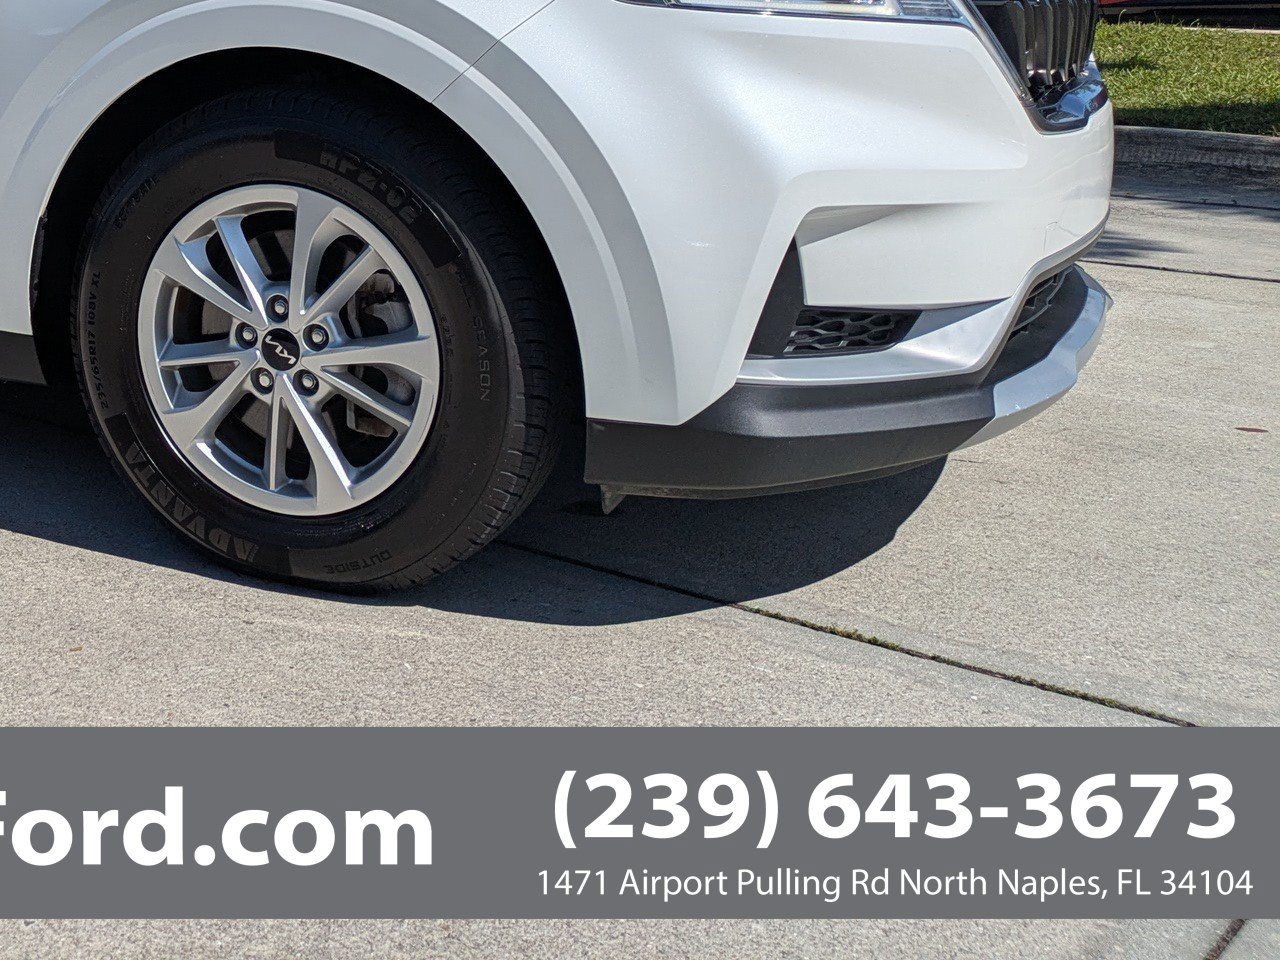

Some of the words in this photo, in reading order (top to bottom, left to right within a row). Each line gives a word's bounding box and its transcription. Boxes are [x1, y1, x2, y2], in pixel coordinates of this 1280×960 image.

[87, 291, 98, 326] 108V
[89, 270, 102, 289] XL
[87, 329, 109, 410] 235/65R17
[472, 315, 492, 402] SEASON
[124, 441, 258, 562] ADVANTA
[322, 549, 393, 575] OUTSIDE
